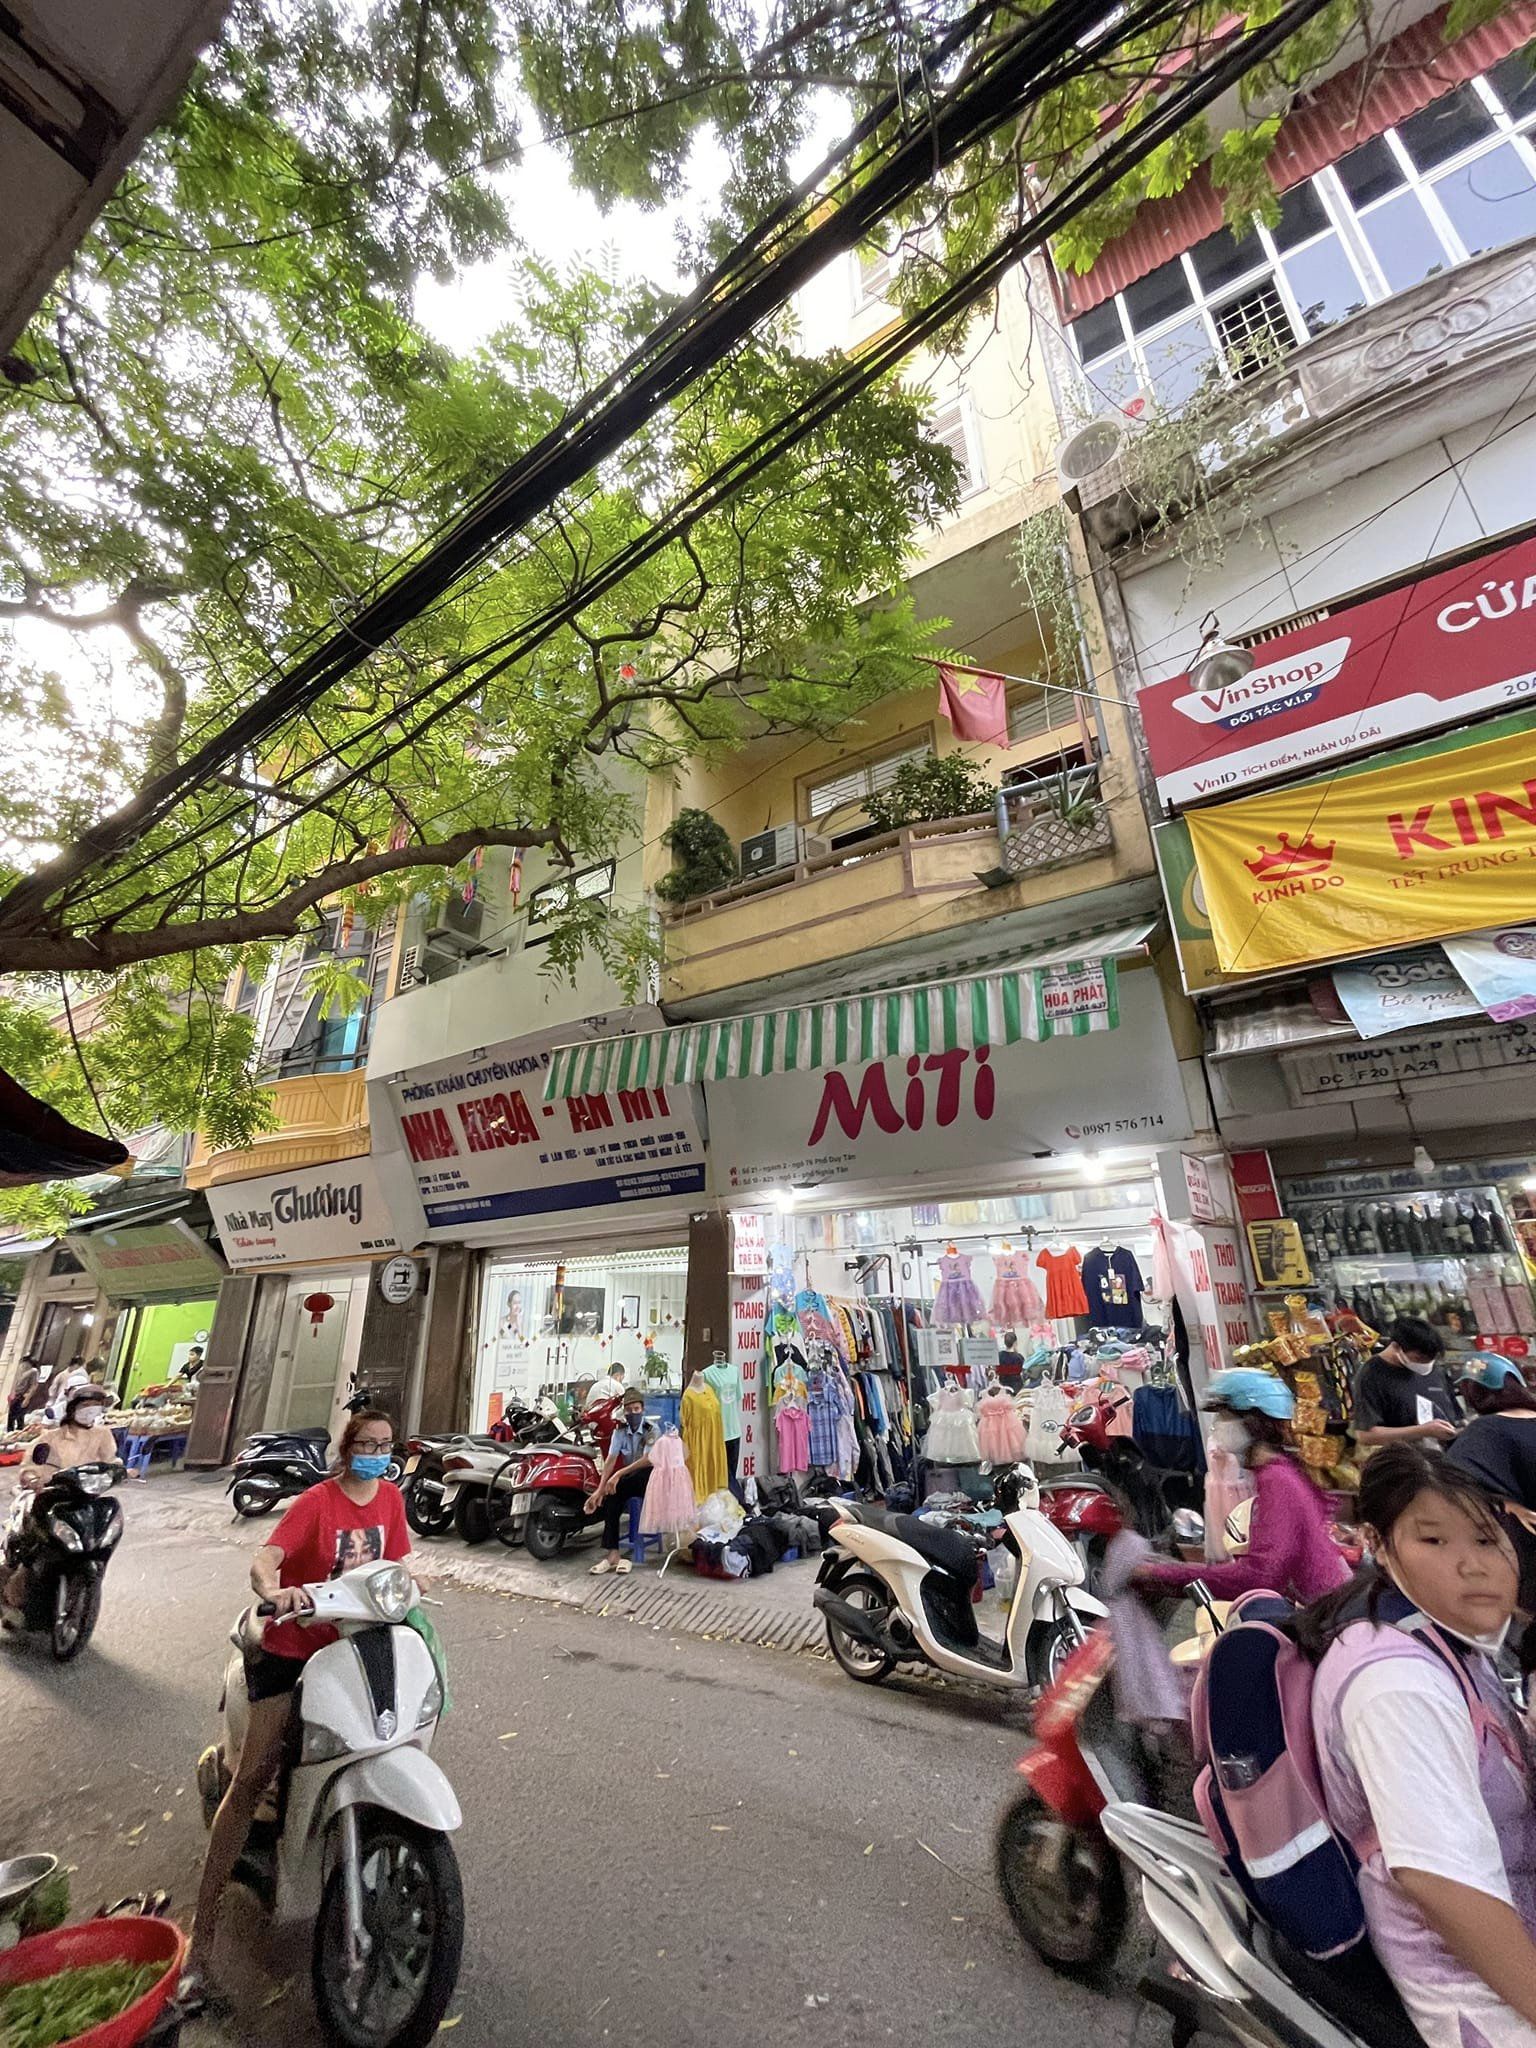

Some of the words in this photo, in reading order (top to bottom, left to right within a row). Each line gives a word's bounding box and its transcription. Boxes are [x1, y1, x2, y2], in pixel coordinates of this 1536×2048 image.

[1200, 660, 1323, 713] VinShop
[1284, 691, 1313, 707] V.I.P
[1193, 771, 1237, 793] VinID
[1241, 762, 1268, 777] TÍCH
[1436, 850, 1519, 881] TRUNG
[1252, 880, 1306, 905] KINH
[401, 1082, 435, 1103] PHÒNG
[467, 1061, 509, 1087] CHUYÊN
[509, 1055, 539, 1076] KHOA
[1403, 1060, 1439, 1074] A29
[807, 1045, 996, 1147] MiTi
[401, 1108, 459, 1162] NHA
[457, 1090, 540, 1152] KHOA
[1082, 1122, 1112, 1136] 0987
[1115, 1118, 1139, 1131] 576
[1141, 1114, 1164, 1128] 714
[224, 1211, 249, 1232] Nhà
[250, 1209, 273, 1231] May
[1214, 1282, 1245, 1305] TRANG
[734, 1301, 764, 1319] TRANG
[745, 1424, 753, 1443] &
